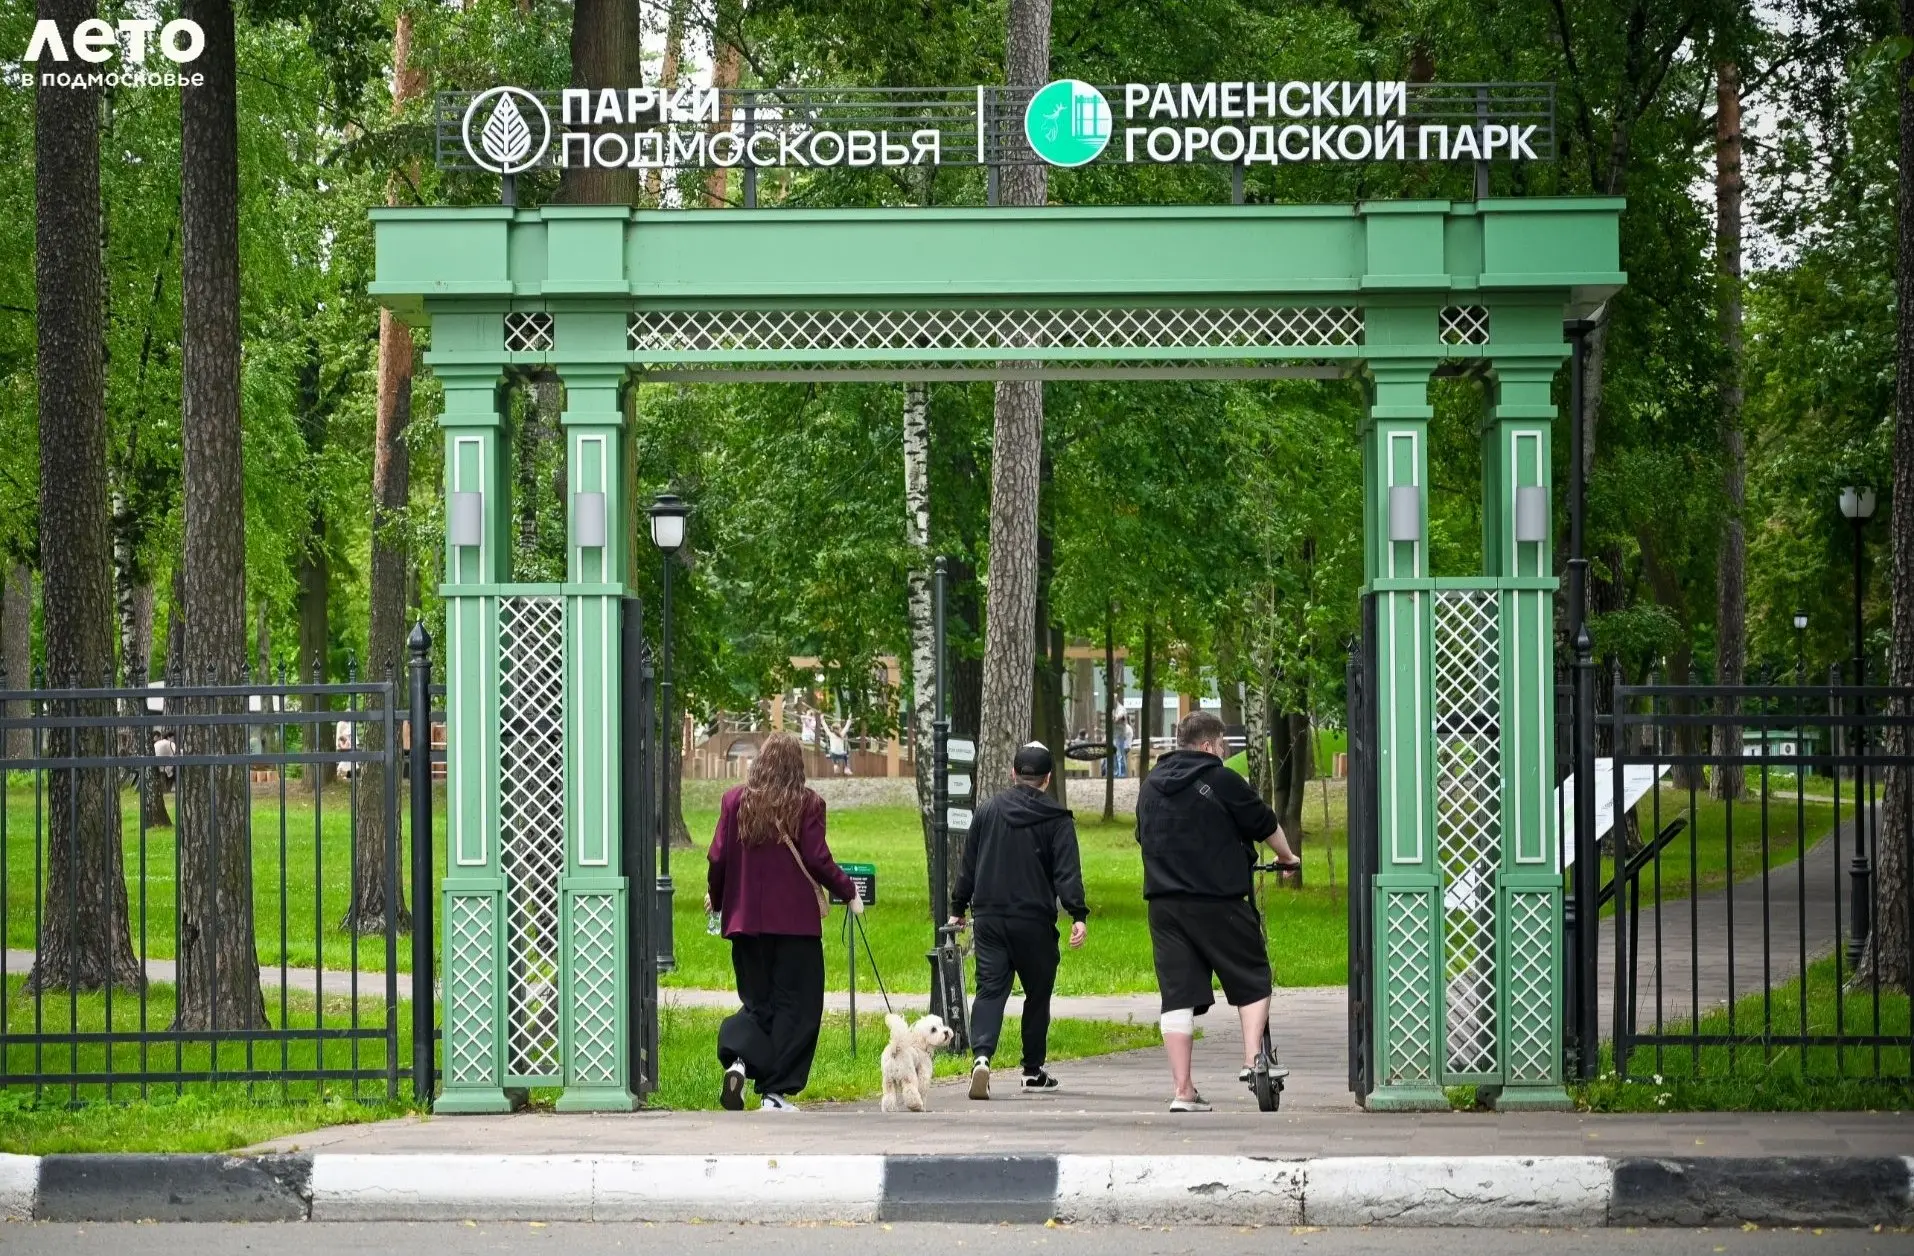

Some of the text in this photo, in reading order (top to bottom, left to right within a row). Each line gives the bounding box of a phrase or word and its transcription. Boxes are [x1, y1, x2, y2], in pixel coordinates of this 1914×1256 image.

[562, 88, 720, 123] ПАРКИ
[1125, 81, 1407, 118] РАМЕНСКИЙ
[562, 129, 941, 168] ПОДМОСКОВЬЯ
[1125, 120, 1539, 165] ГОРОДСКОЙ ПАРК
